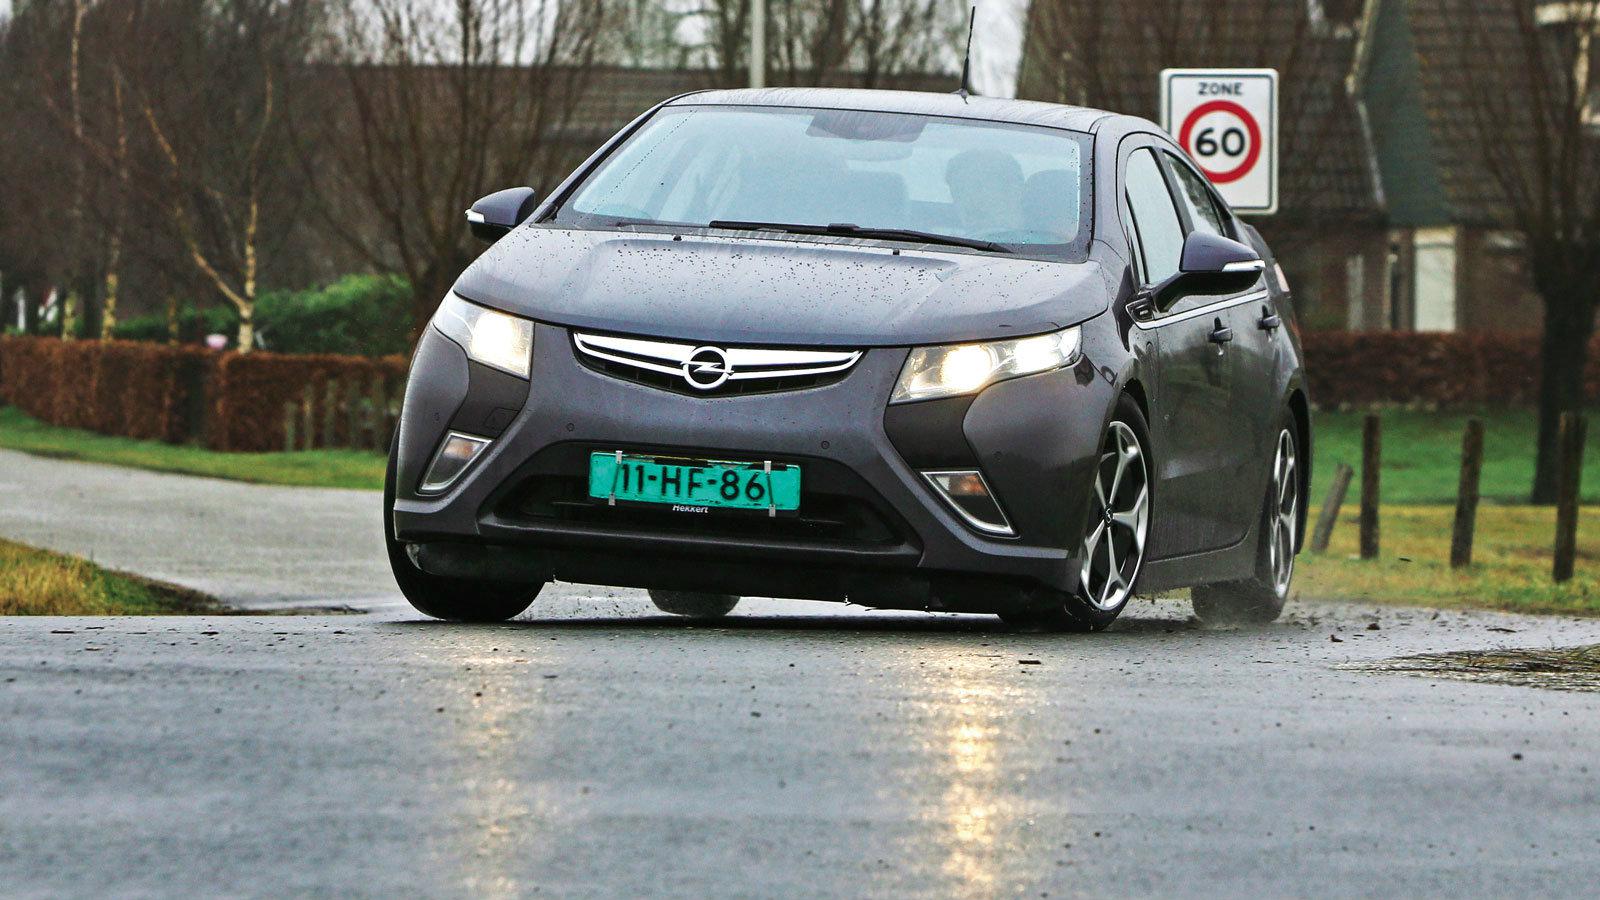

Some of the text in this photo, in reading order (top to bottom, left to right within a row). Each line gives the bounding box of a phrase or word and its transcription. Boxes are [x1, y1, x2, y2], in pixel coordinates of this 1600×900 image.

[1198, 82, 1243, 96] ZONE
[1196, 127, 1245, 157] 60
[622, 463, 765, 500] 11-HF-86
[672, 504, 709, 514] Hekkert
